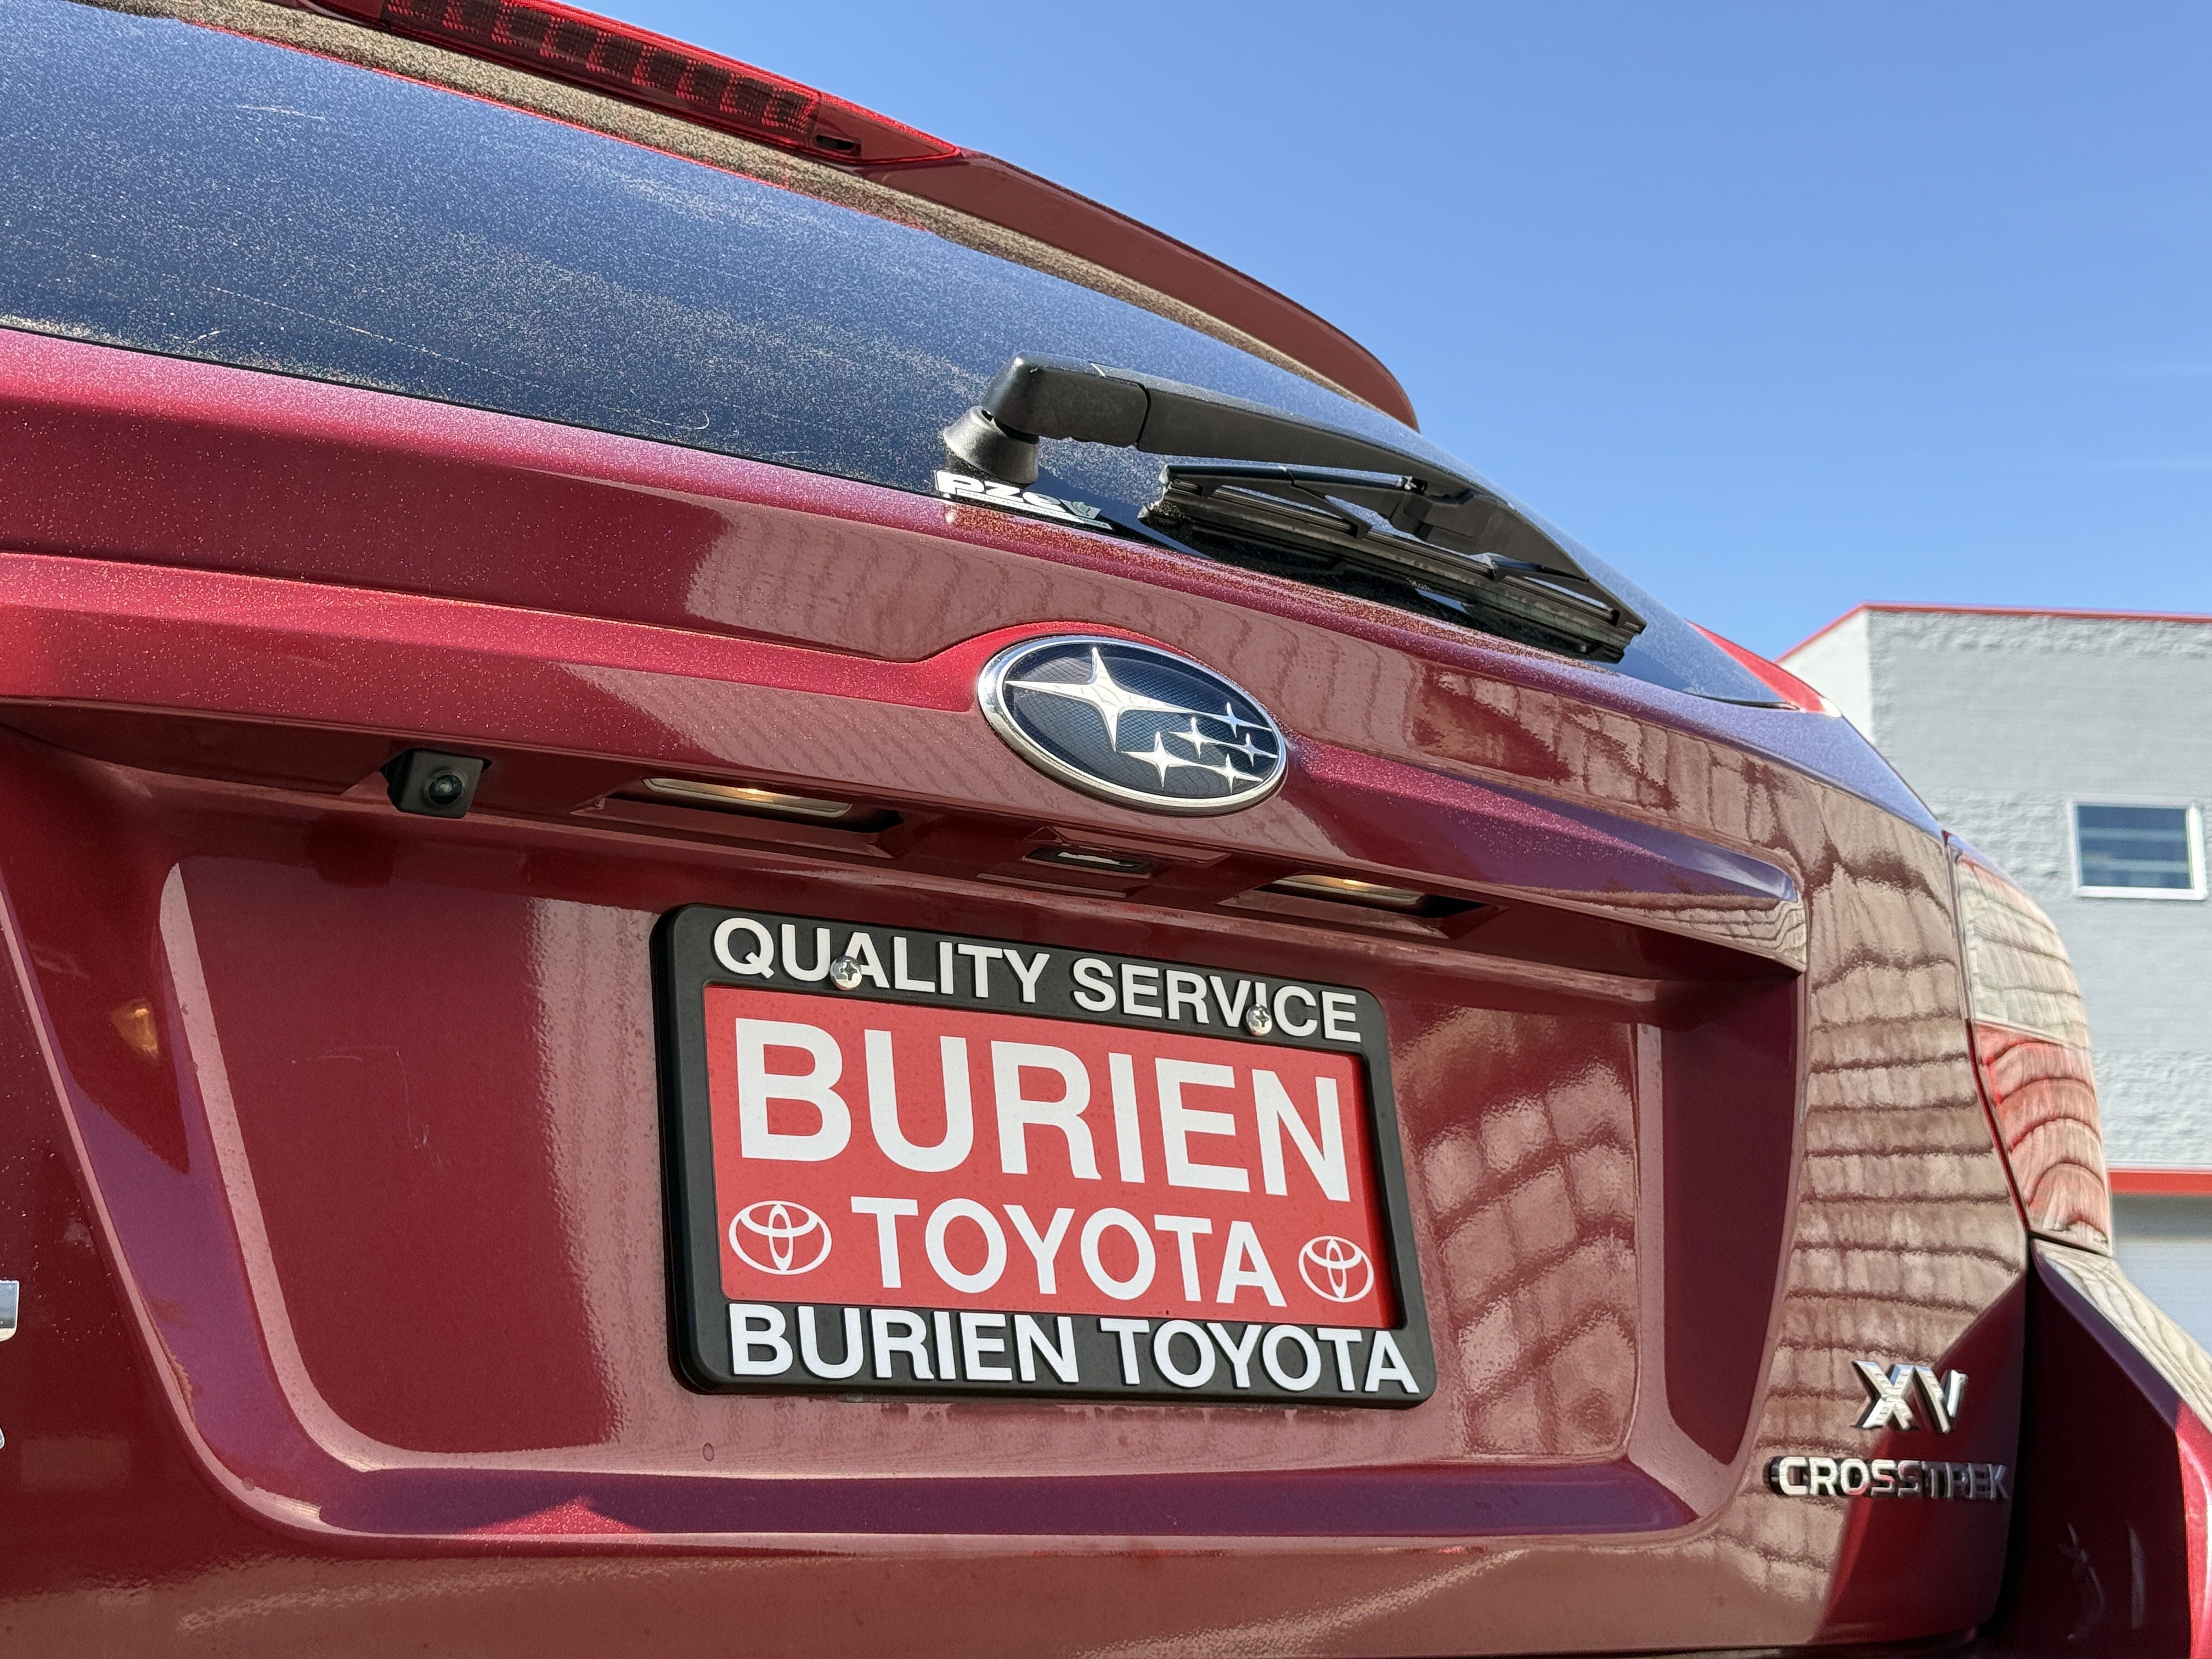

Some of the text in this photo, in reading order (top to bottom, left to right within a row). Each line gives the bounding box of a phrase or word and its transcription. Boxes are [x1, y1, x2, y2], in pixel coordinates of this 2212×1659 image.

[713, 917, 1051, 1003] QUALITY
[735, 1017, 1351, 1203] BURIEN
[850, 1195, 1288, 1308] TOYOTA
[729, 1302, 1420, 1394] BURIEN TOYOTA
[1853, 1359, 1969, 1434] XV
[1774, 1455, 2011, 1500] CROSSTREK
